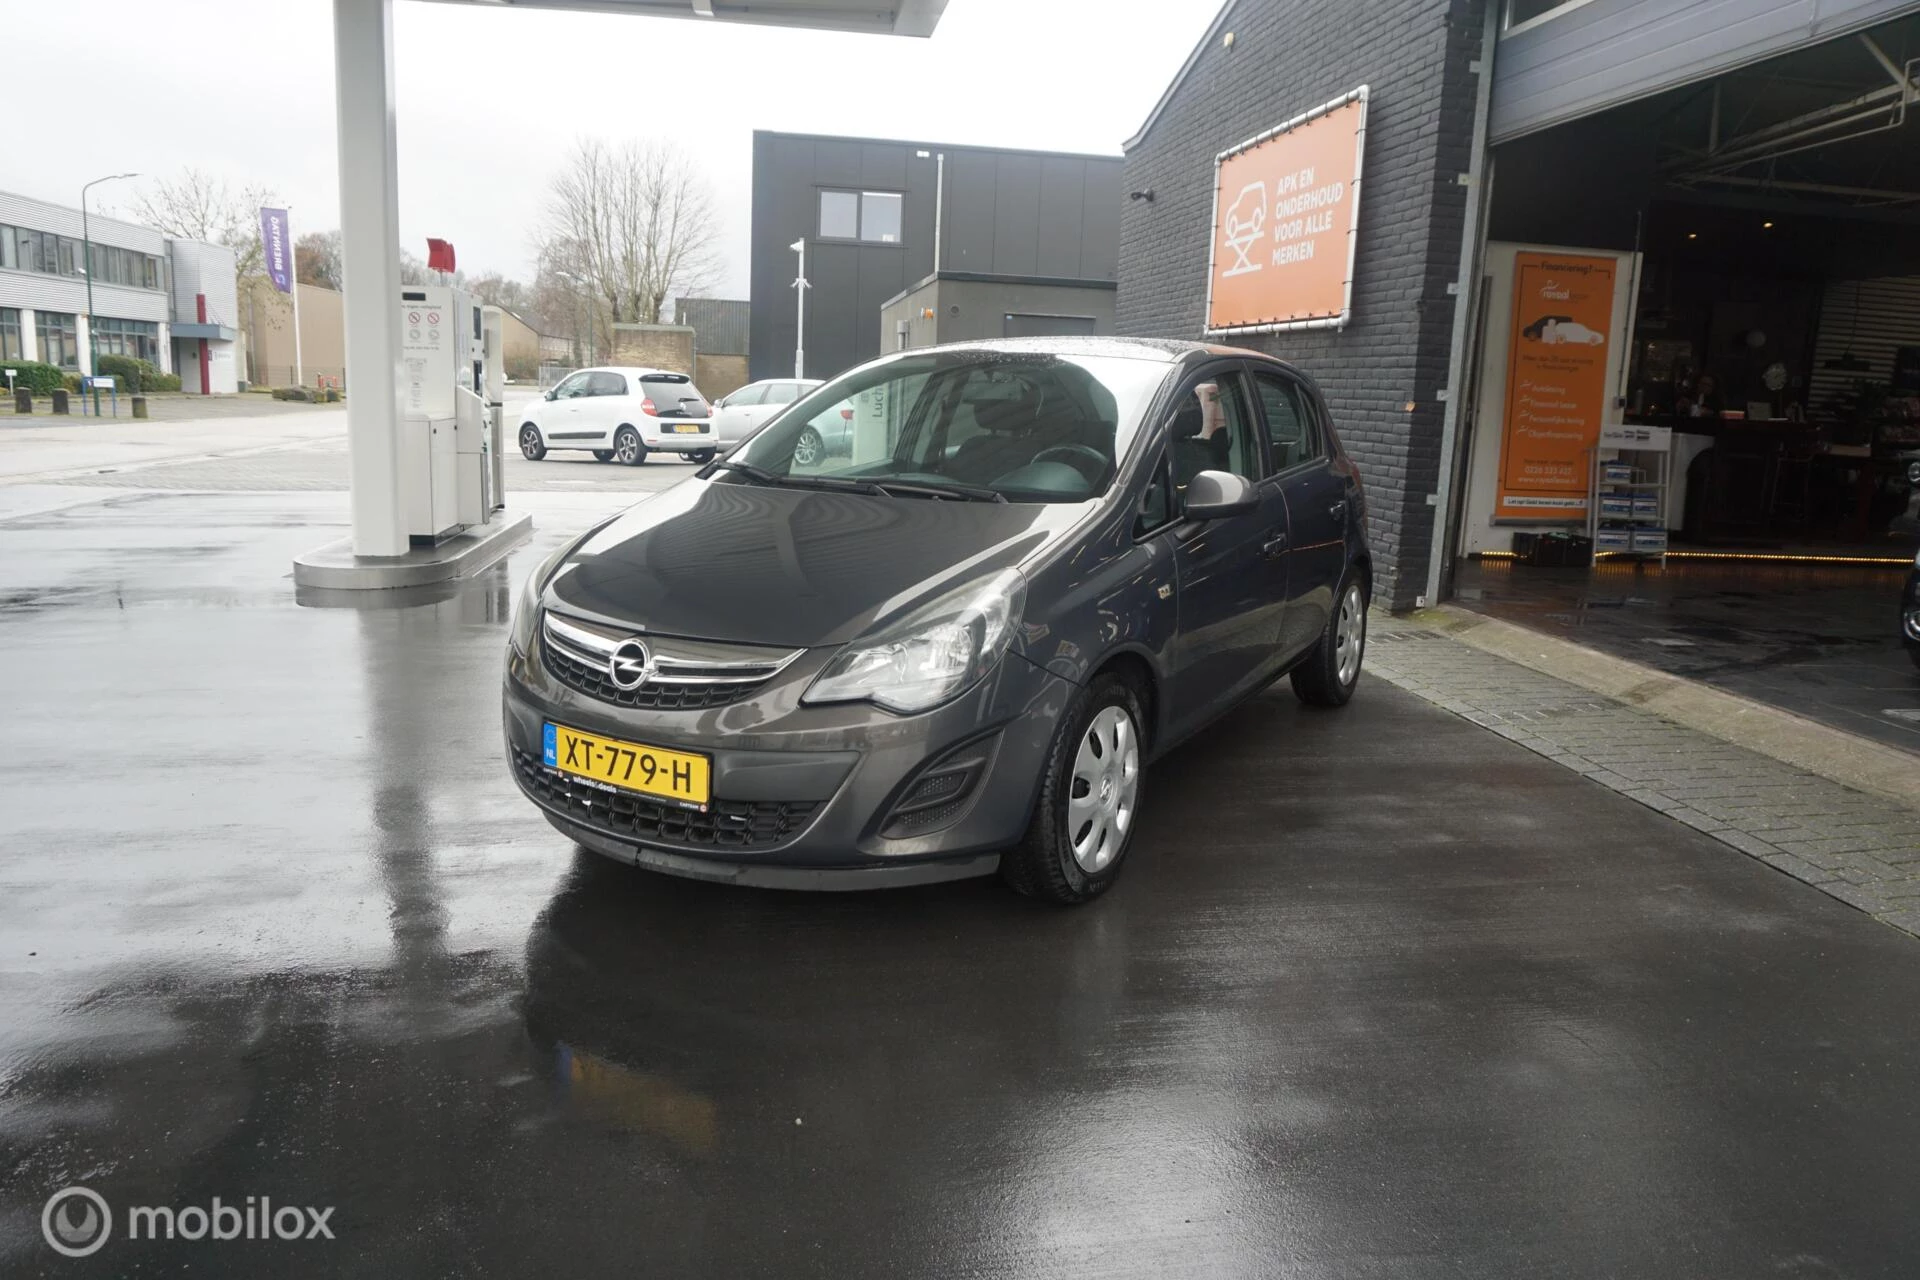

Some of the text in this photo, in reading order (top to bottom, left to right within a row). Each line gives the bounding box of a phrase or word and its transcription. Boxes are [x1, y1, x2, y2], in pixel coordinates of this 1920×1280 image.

[1277, 166, 1315, 196] APK EN
[1276, 181, 1344, 220] ONDERHOUD
[1275, 210, 1333, 243] VOOR ALLE
[1272, 239, 1315, 267] MERKEN
[545, 748, 556, 760] NL
[565, 734, 692, 793] XT-779-H
